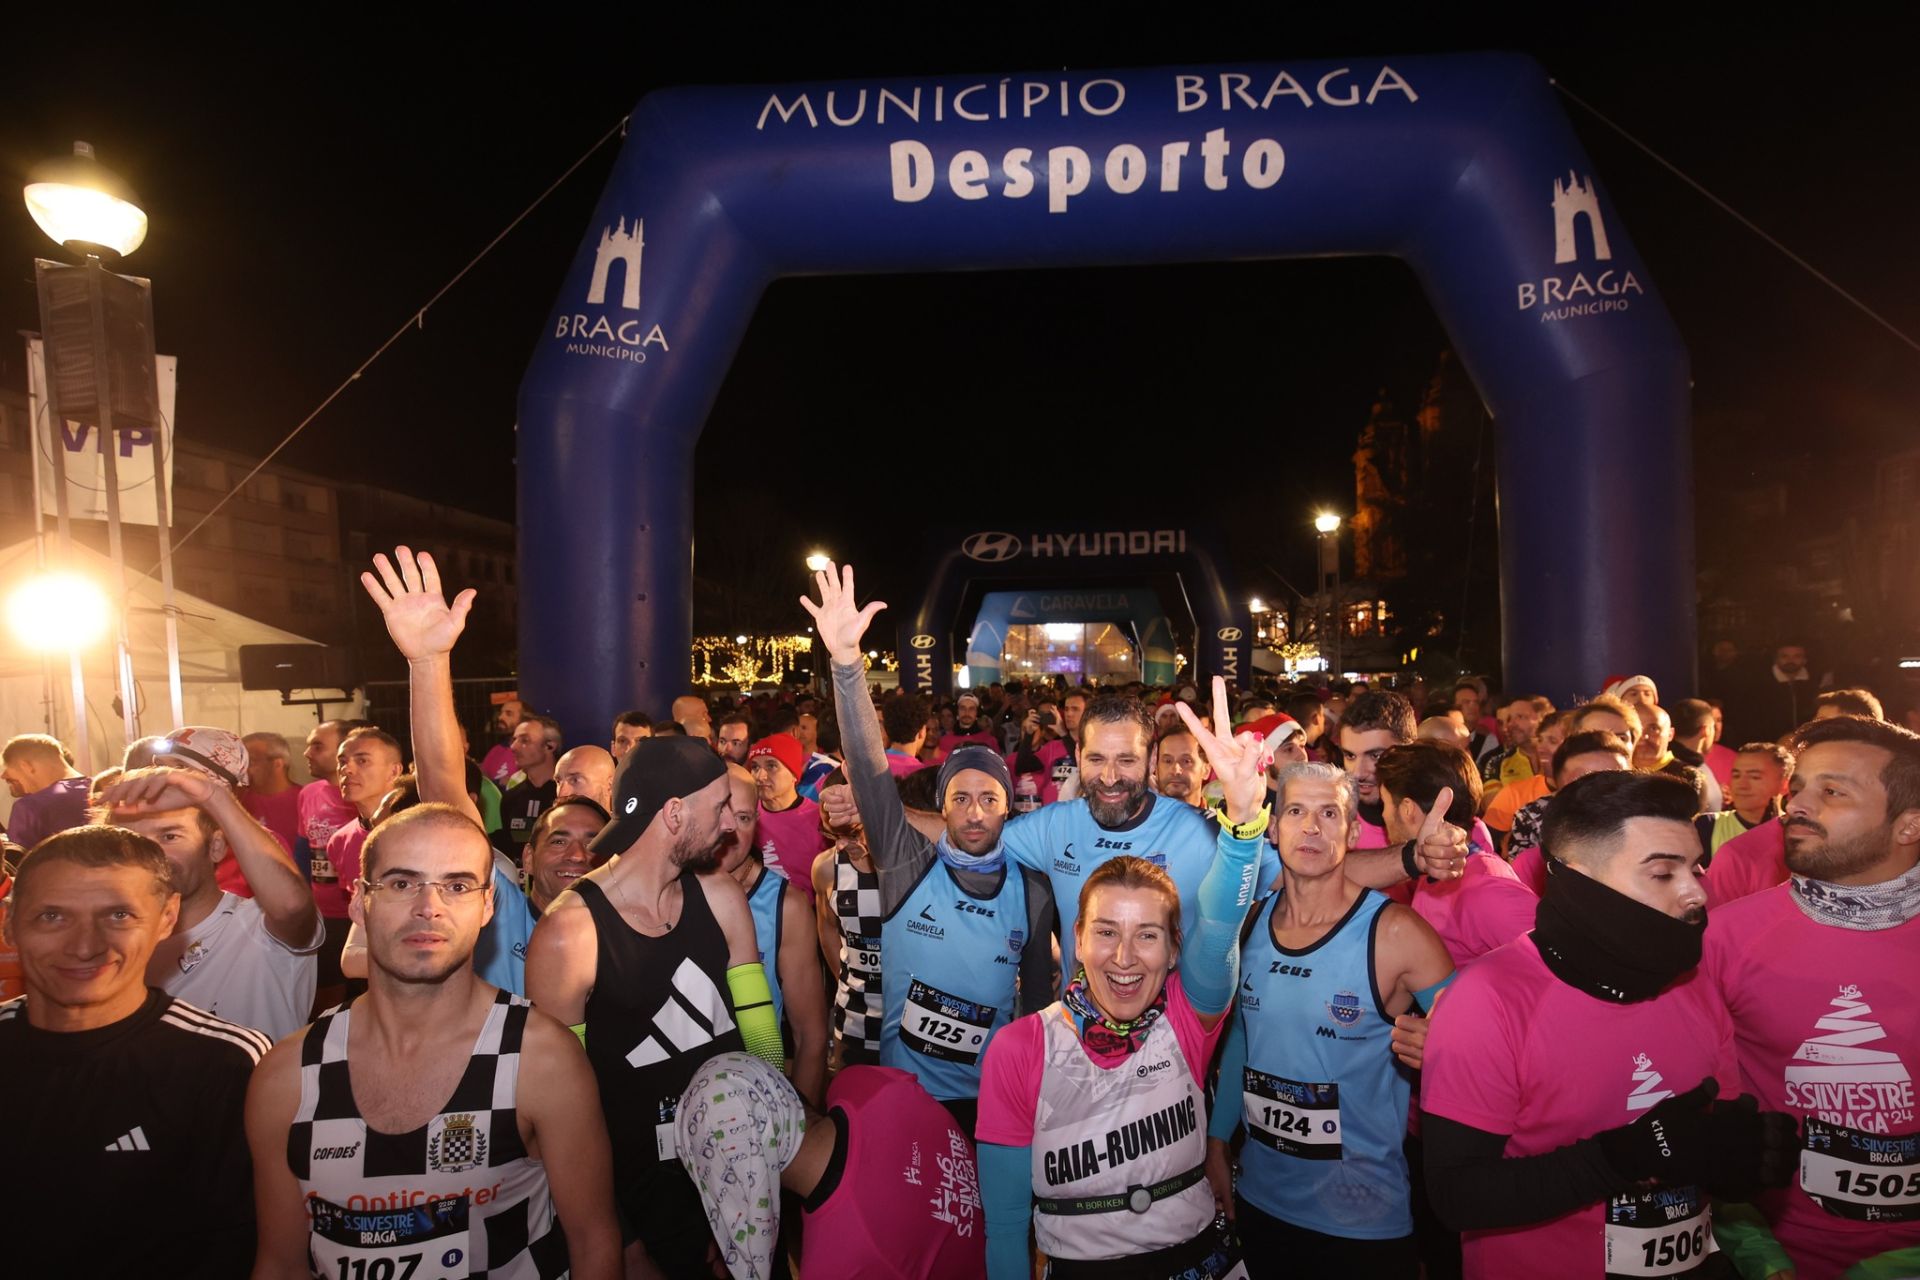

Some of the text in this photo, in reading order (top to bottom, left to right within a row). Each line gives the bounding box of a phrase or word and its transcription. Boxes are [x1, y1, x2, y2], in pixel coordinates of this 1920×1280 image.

[756, 65, 1419, 130] MUNICÍPIO BRAGA
[889, 127, 1285, 213] Desporto
[1518, 270, 1643, 310] BRAGA
[1541, 299, 1629, 323] MUNICÍPIO
[555, 314, 669, 352] BRAGA
[566, 343, 647, 364] MUNICÍPIO
[1032, 530, 1186, 557] HYUNDAI
[1040, 593, 1129, 612] CARAVELA
[1094, 837, 1133, 850] Zeus
[1236, 863, 1255, 906] KIPRUN
[954, 900, 996, 918] Zeus
[906, 919, 945, 937] CARAVELA
[1269, 961, 1313, 978] Zeus
[918, 1016, 966, 1044] 1125
[1148, 1060, 1171, 1073] PACTO
[1263, 1106, 1312, 1137] 1124
[1043, 1094, 1197, 1187] GAIA-RUNNING
[1869, 1151, 1903, 1163] BRAGA
[1835, 1169, 1920, 1199] 1505
[1086, 1198, 1124, 1210] BORIKEN
[1665, 1203, 1690, 1220] BRAGA
[1641, 1225, 1703, 1268] 1506
[337, 1252, 423, 1280] 1107
